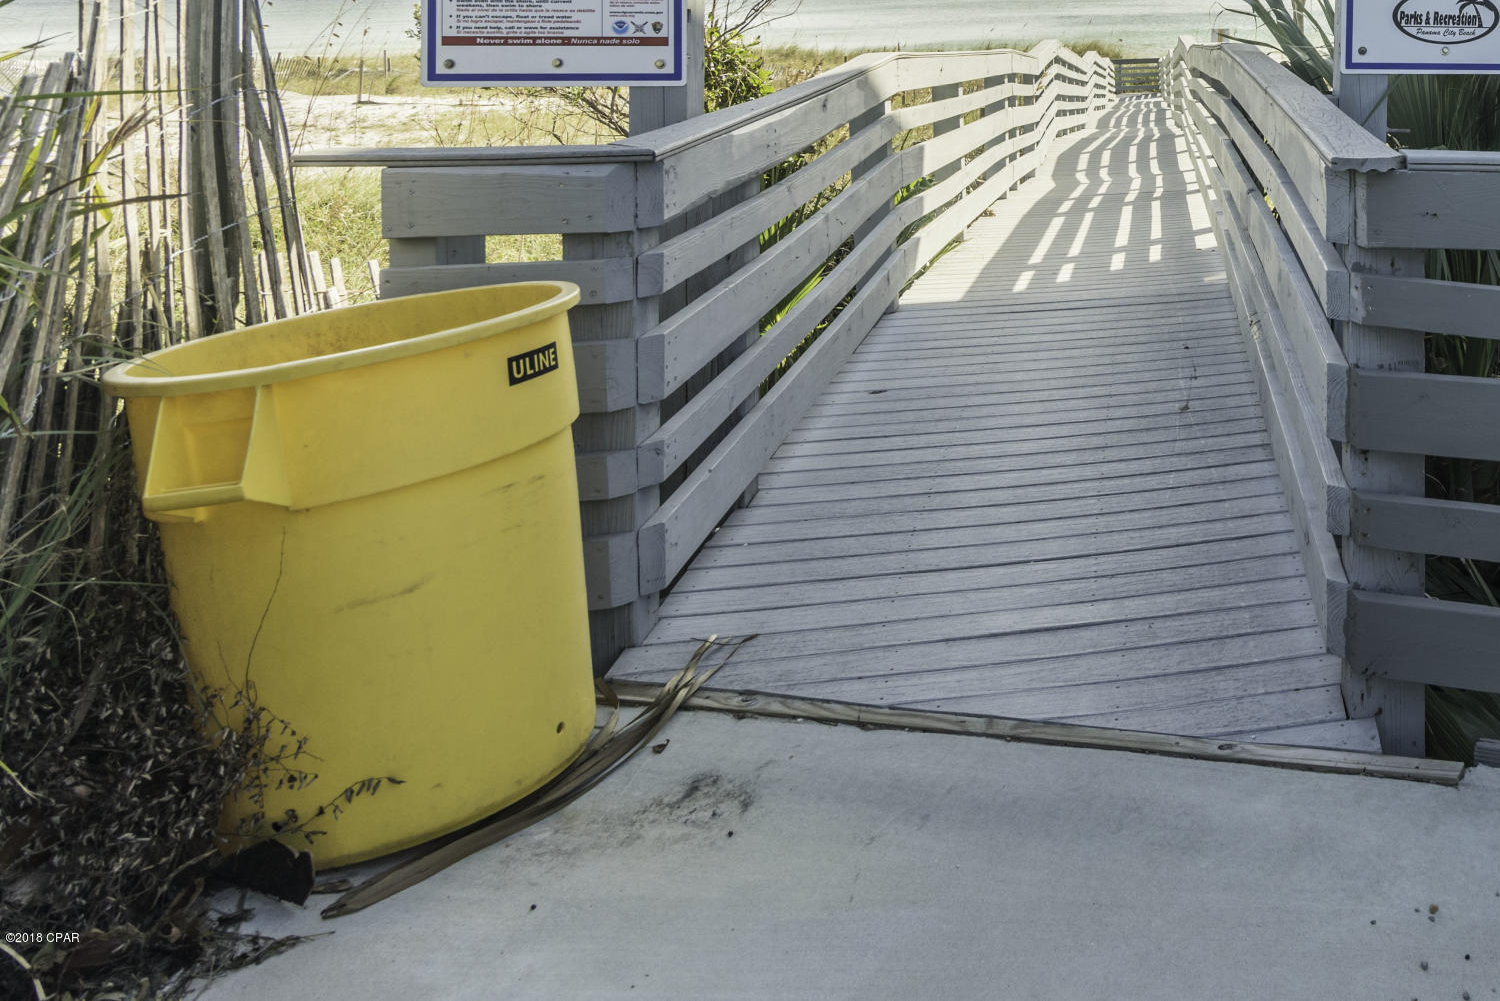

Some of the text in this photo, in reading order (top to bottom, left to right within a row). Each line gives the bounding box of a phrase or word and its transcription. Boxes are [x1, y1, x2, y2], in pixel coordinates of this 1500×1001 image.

[1399, 10, 1477, 26] Parks & Recreation
[1442, 28, 1456, 37] City
[512, 347, 556, 379] ULINE
